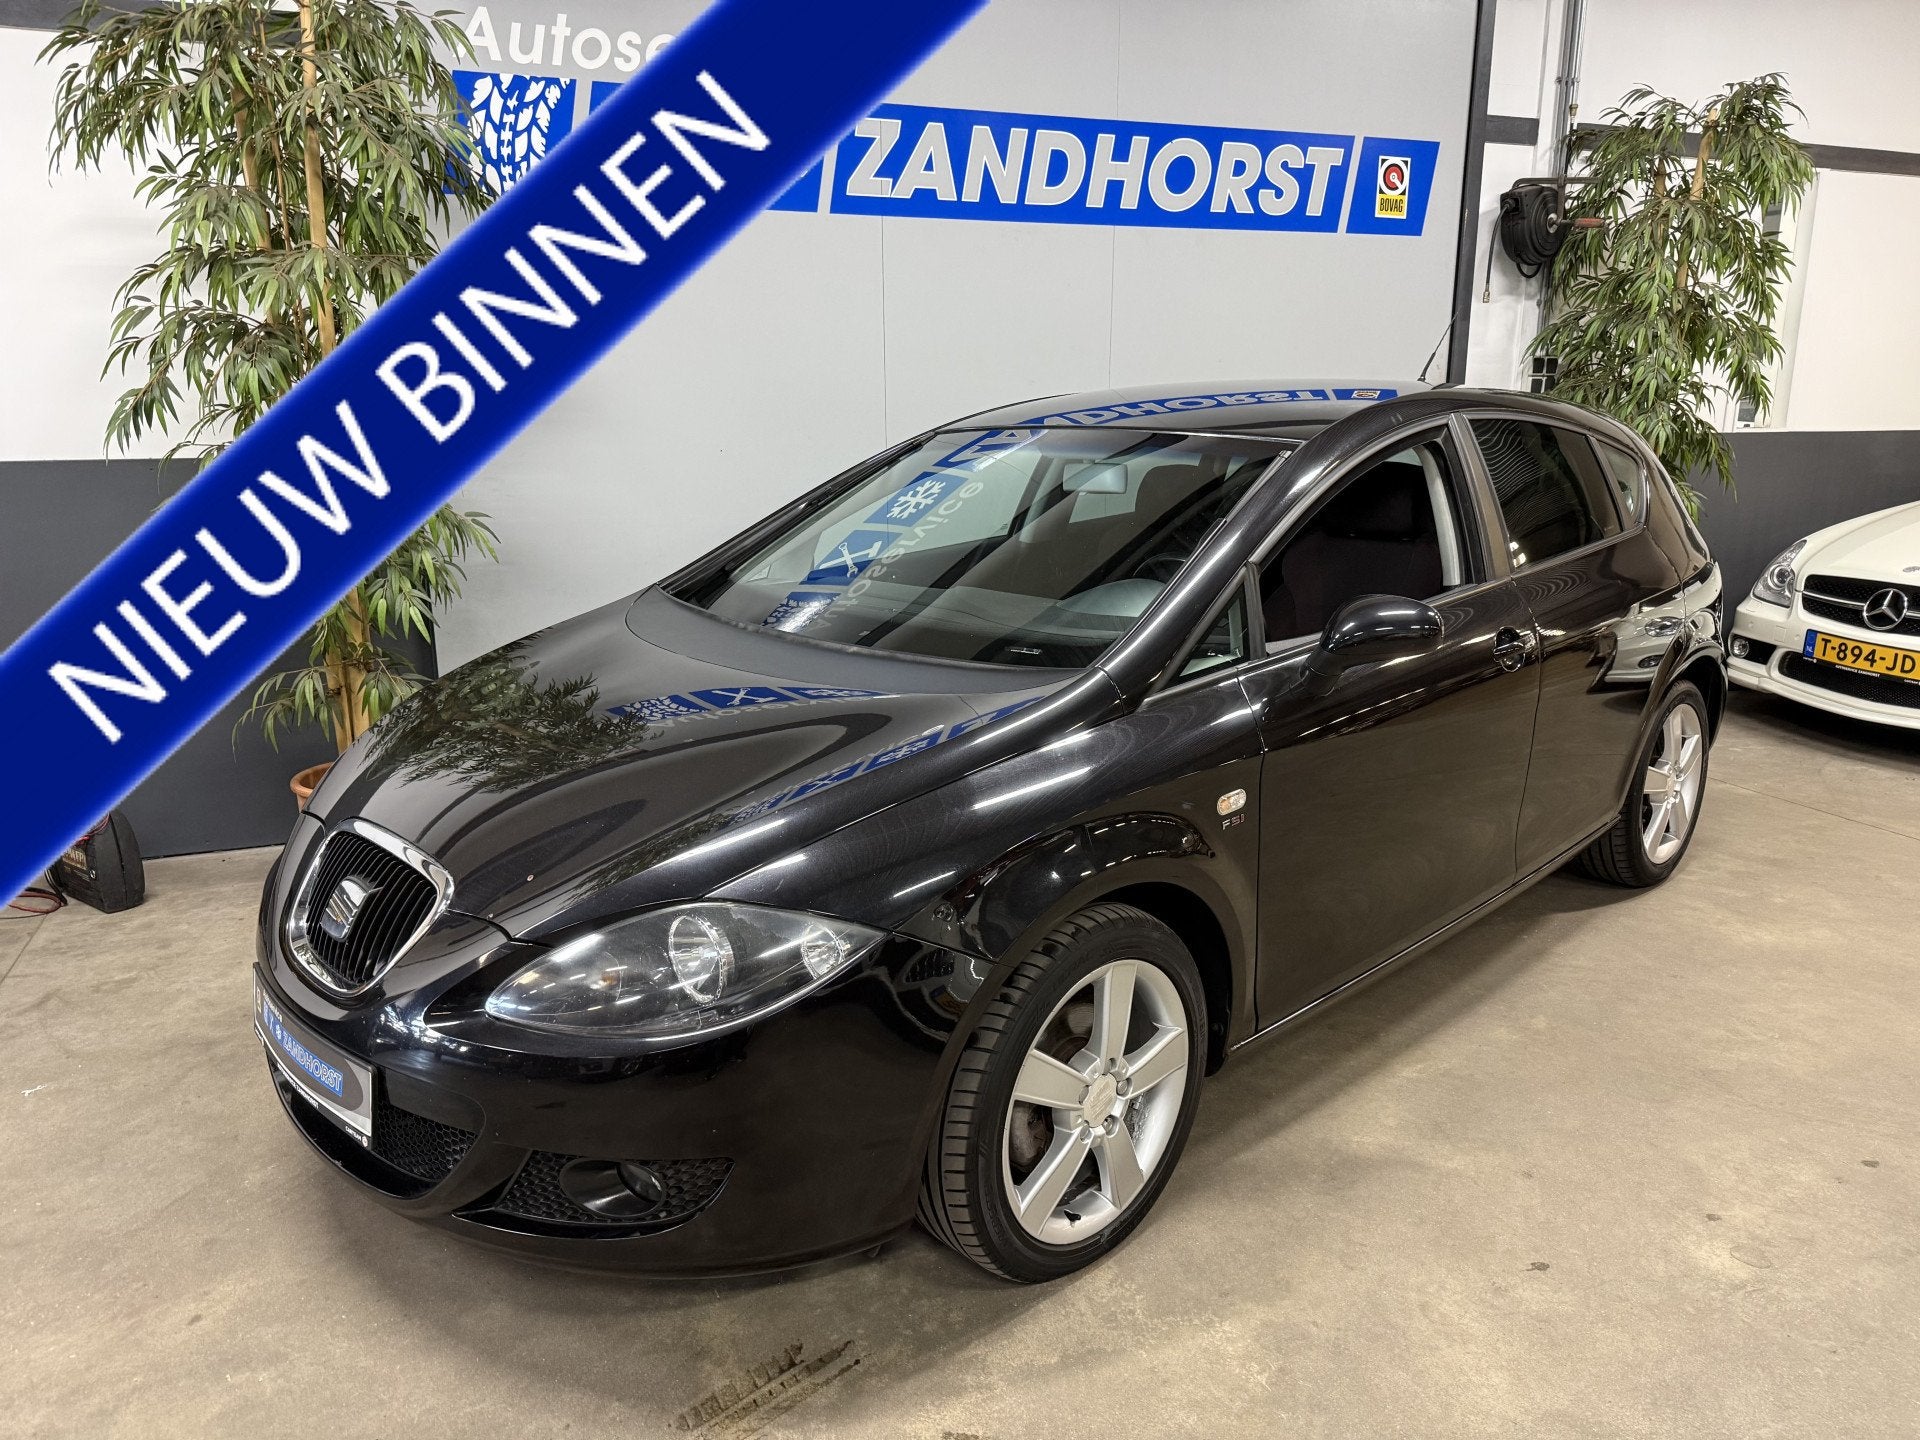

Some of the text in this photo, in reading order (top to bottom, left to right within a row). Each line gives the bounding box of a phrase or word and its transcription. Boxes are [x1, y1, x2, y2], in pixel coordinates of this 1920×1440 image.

[846, 117, 1345, 217] ZANDHORST
[1379, 197, 1404, 213] BOVAG
[1820, 637, 1917, 674] T-894-JD
[282, 1029, 342, 1092] ZANDHORST
